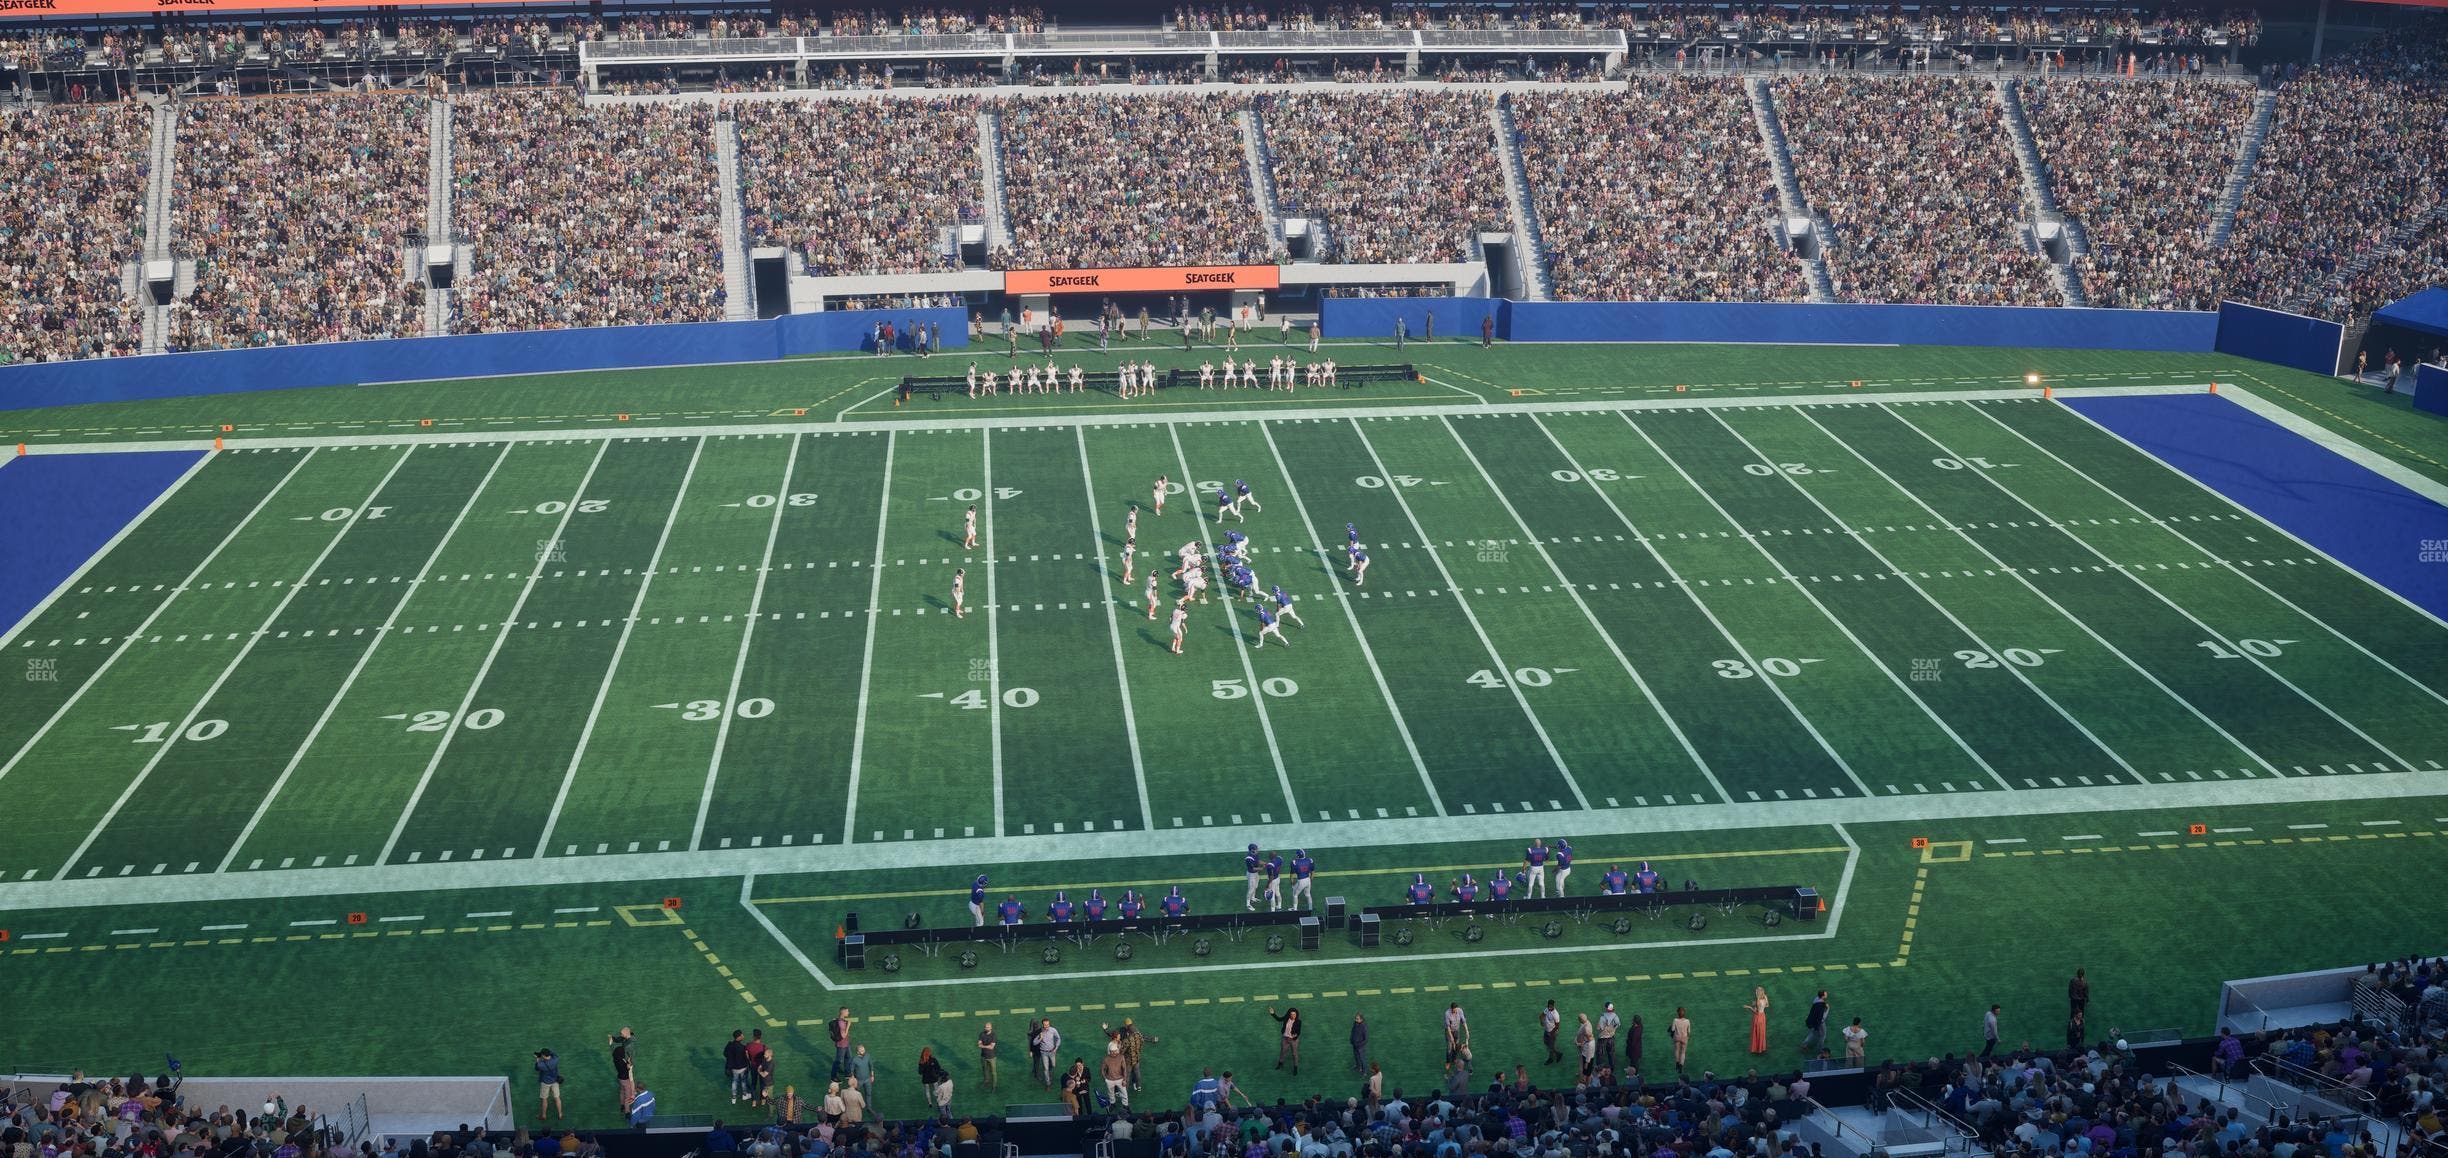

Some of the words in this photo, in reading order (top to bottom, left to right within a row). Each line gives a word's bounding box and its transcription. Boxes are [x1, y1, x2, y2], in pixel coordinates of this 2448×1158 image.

[1049, 274, 1099, 287] SEATGEEK
[1185, 272, 1235, 285] SEATGEEK
[1953, 648, 2045, 669] 20
[2196, 638, 2282, 658] 10
[1466, 667, 1553, 688] 40
[1711, 657, 1801, 679] 30
[950, 687, 1040, 709] 40
[1212, 677, 1299, 699] 50
[682, 697, 775, 721] 30
[405, 708, 506, 732] 20
[131, 719, 230, 743] 10
[668, 899, 677, 907] 30
[352, 914, 361, 922] 20
